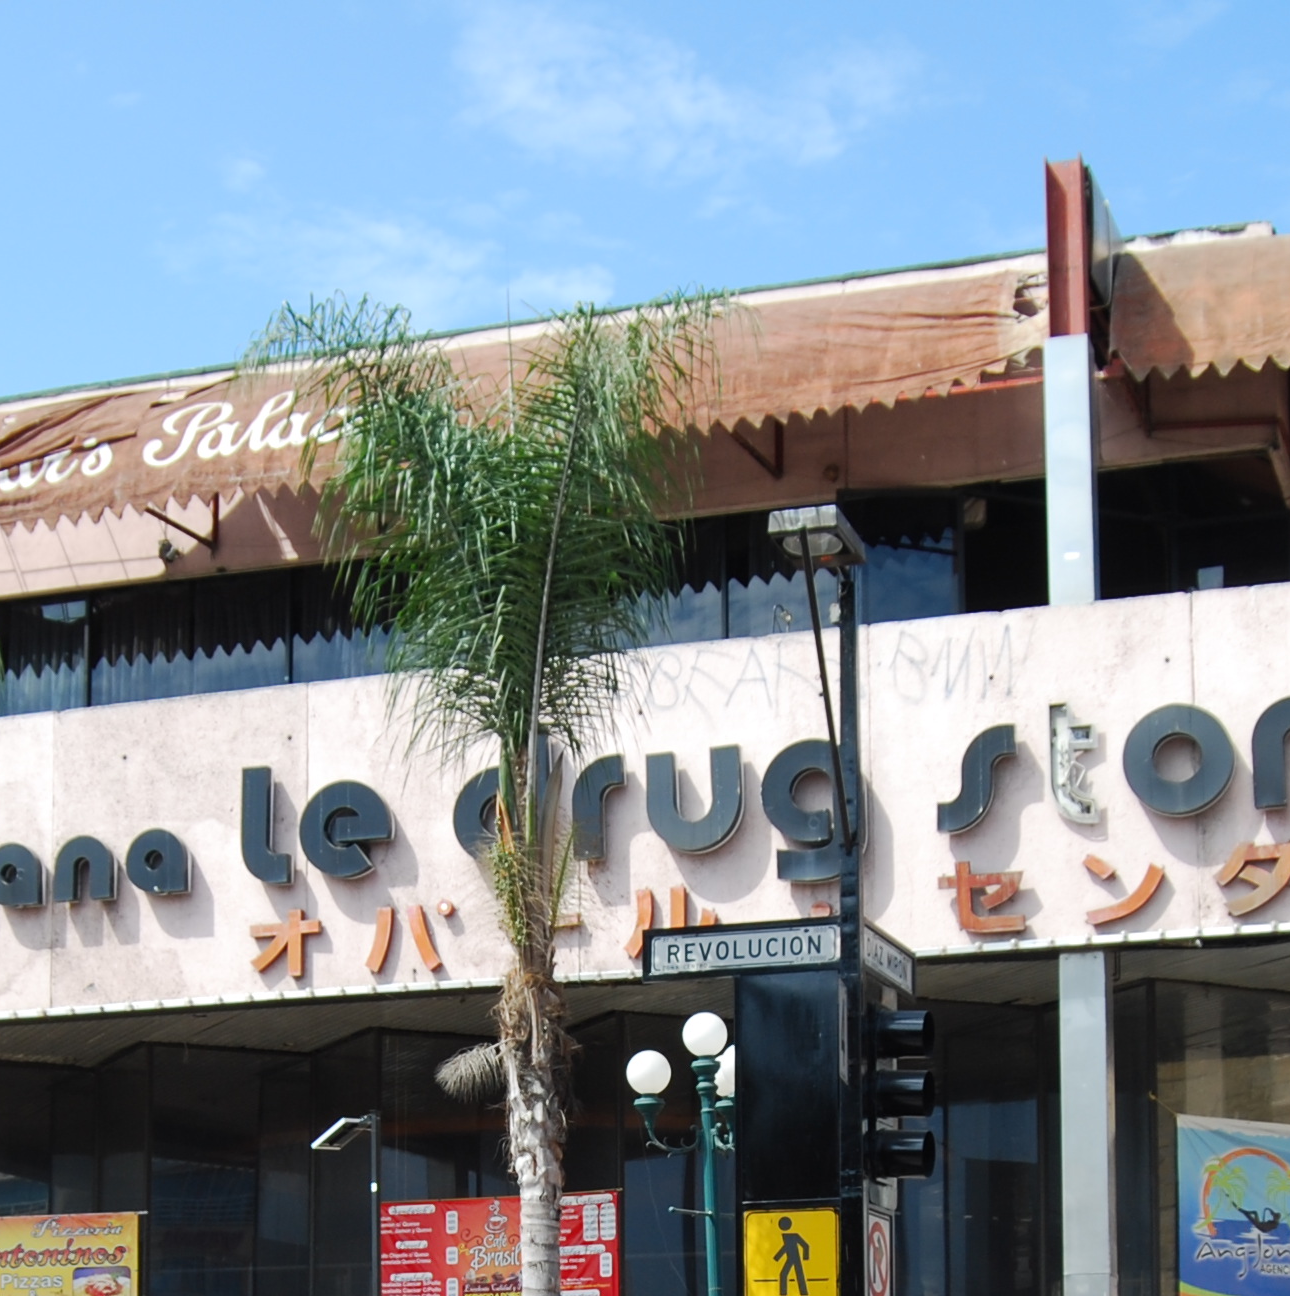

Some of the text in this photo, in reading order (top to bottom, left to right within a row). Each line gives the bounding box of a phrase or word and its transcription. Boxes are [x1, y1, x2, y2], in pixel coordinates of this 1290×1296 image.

[240, 766, 396, 886] le
[453, 733, 865, 885] drug
[667, 934, 822, 964] REVOLUCION
[469, 1242, 522, 1271] Brasil
[0, 1273, 64, 1290] Pizzas
